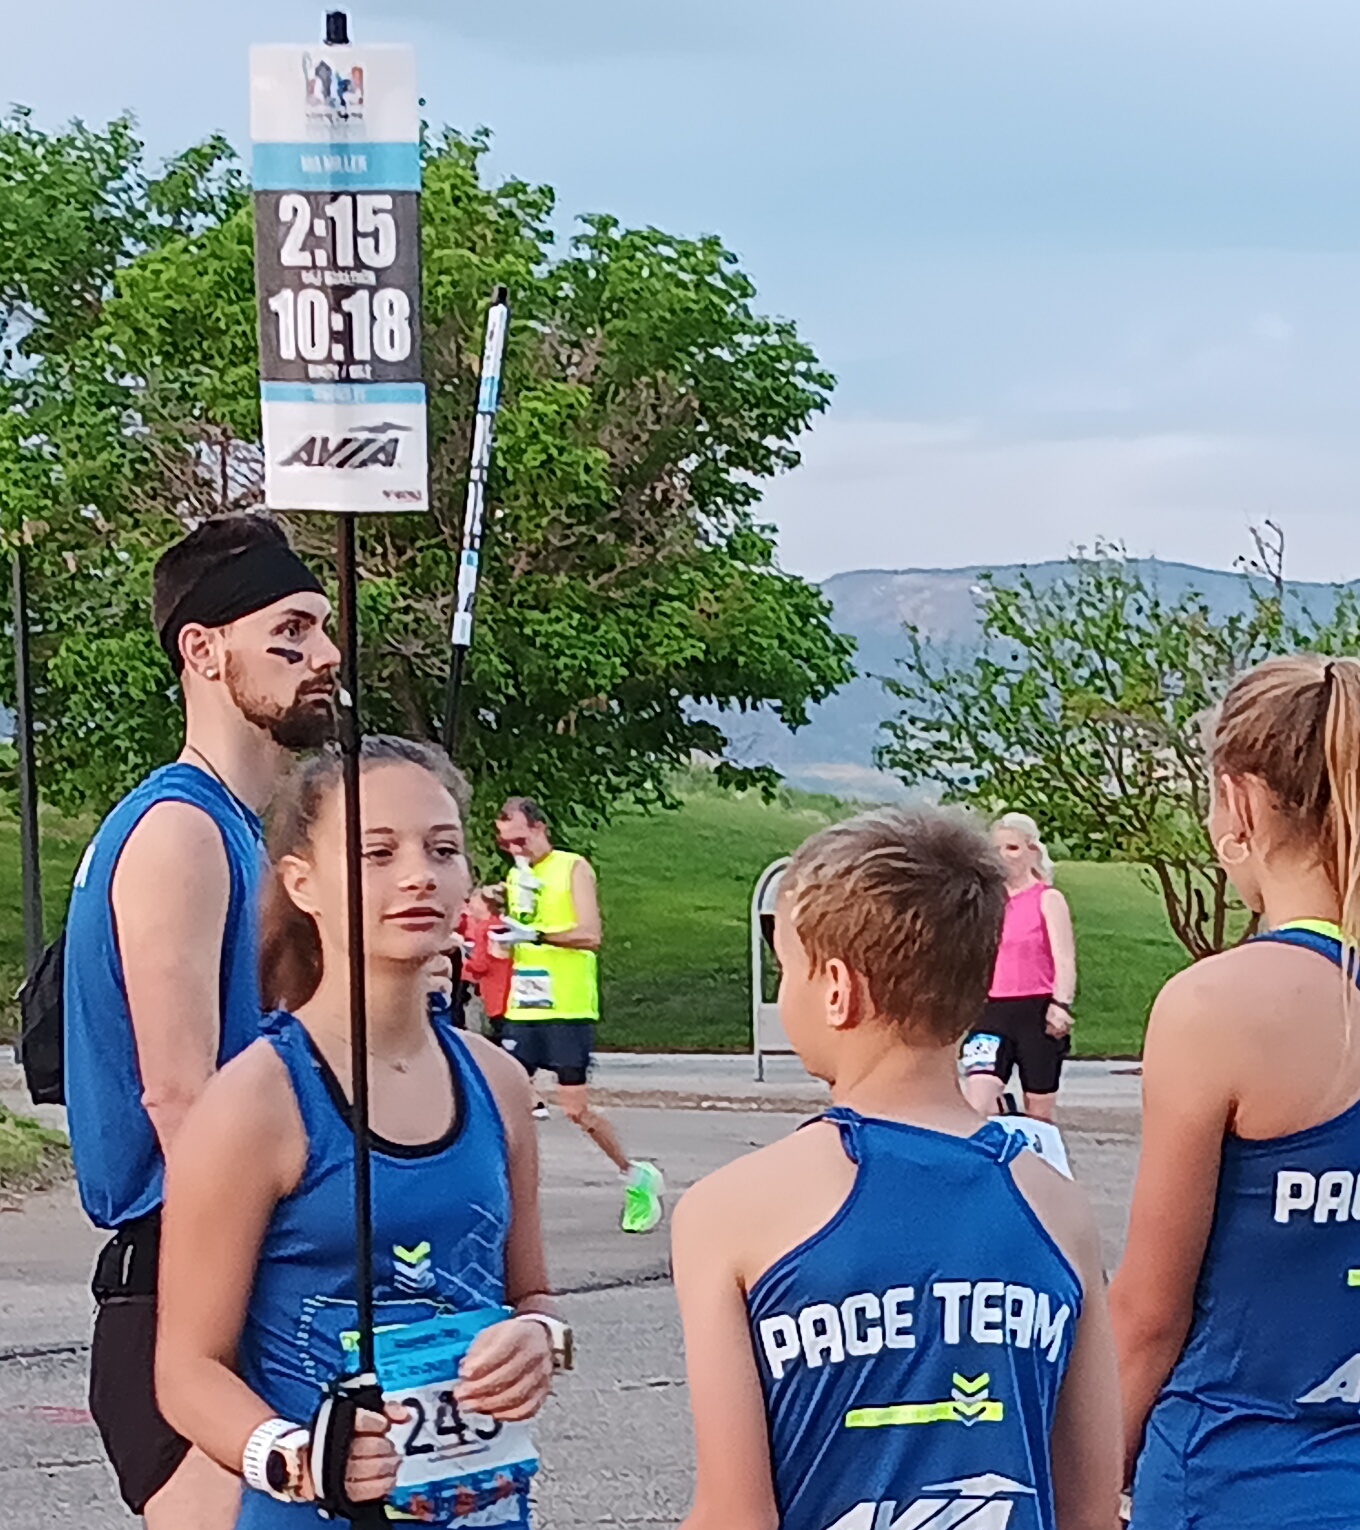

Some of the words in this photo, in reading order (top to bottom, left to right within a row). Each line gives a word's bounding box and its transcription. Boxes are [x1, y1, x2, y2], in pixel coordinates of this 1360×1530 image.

[279, 194, 396, 267] 2:15
[269, 287, 411, 361] 10:18
[277, 435, 399, 468] AVIA
[759, 1286, 916, 1380] PACE
[933, 1281, 1070, 1362] TEAM
